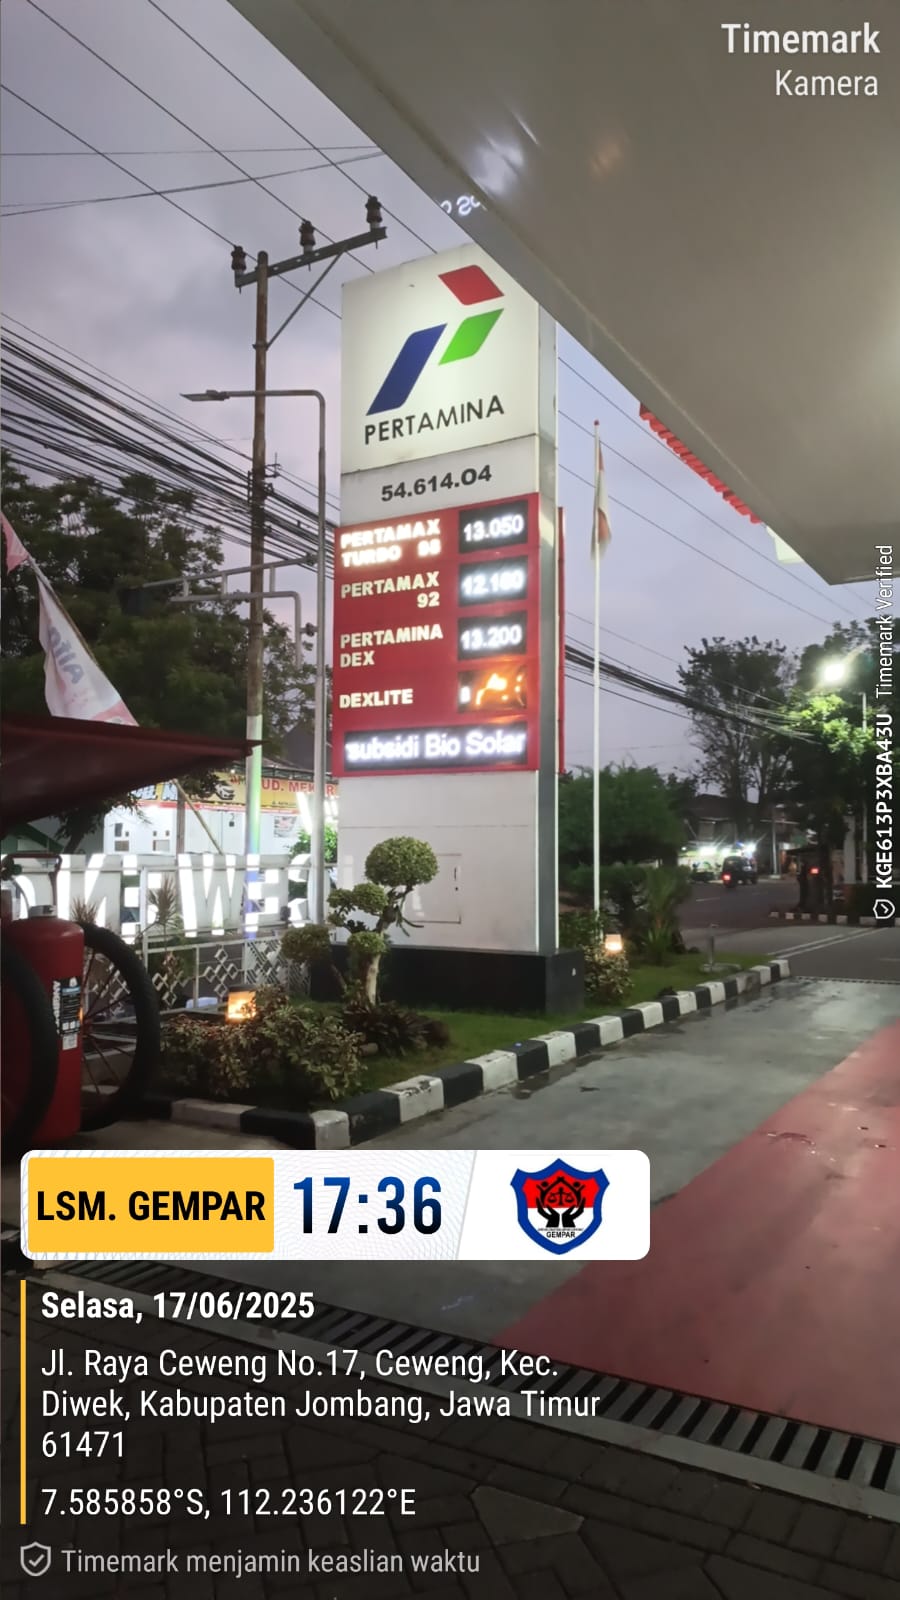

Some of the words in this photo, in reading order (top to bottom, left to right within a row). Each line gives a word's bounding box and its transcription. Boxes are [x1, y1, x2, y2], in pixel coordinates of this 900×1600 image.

[364, 395, 505, 445] PERTAMINA
[381, 464, 492, 502] 54.614.04
[341, 518, 441, 550] PERTAMAX
[463, 514, 525, 542] 13.050
[341, 571, 440, 599] PERTAMAX
[417, 591, 440, 608] 92
[340, 624, 444, 649] PERTAMINA
[461, 625, 523, 650] 13.200
[340, 651, 375, 669] DEX
[339, 689, 414, 709] DEXLITE
[424, 733, 461, 758] Bio
[465, 729, 526, 755] Solar
[262, 778, 284, 794] UD.
